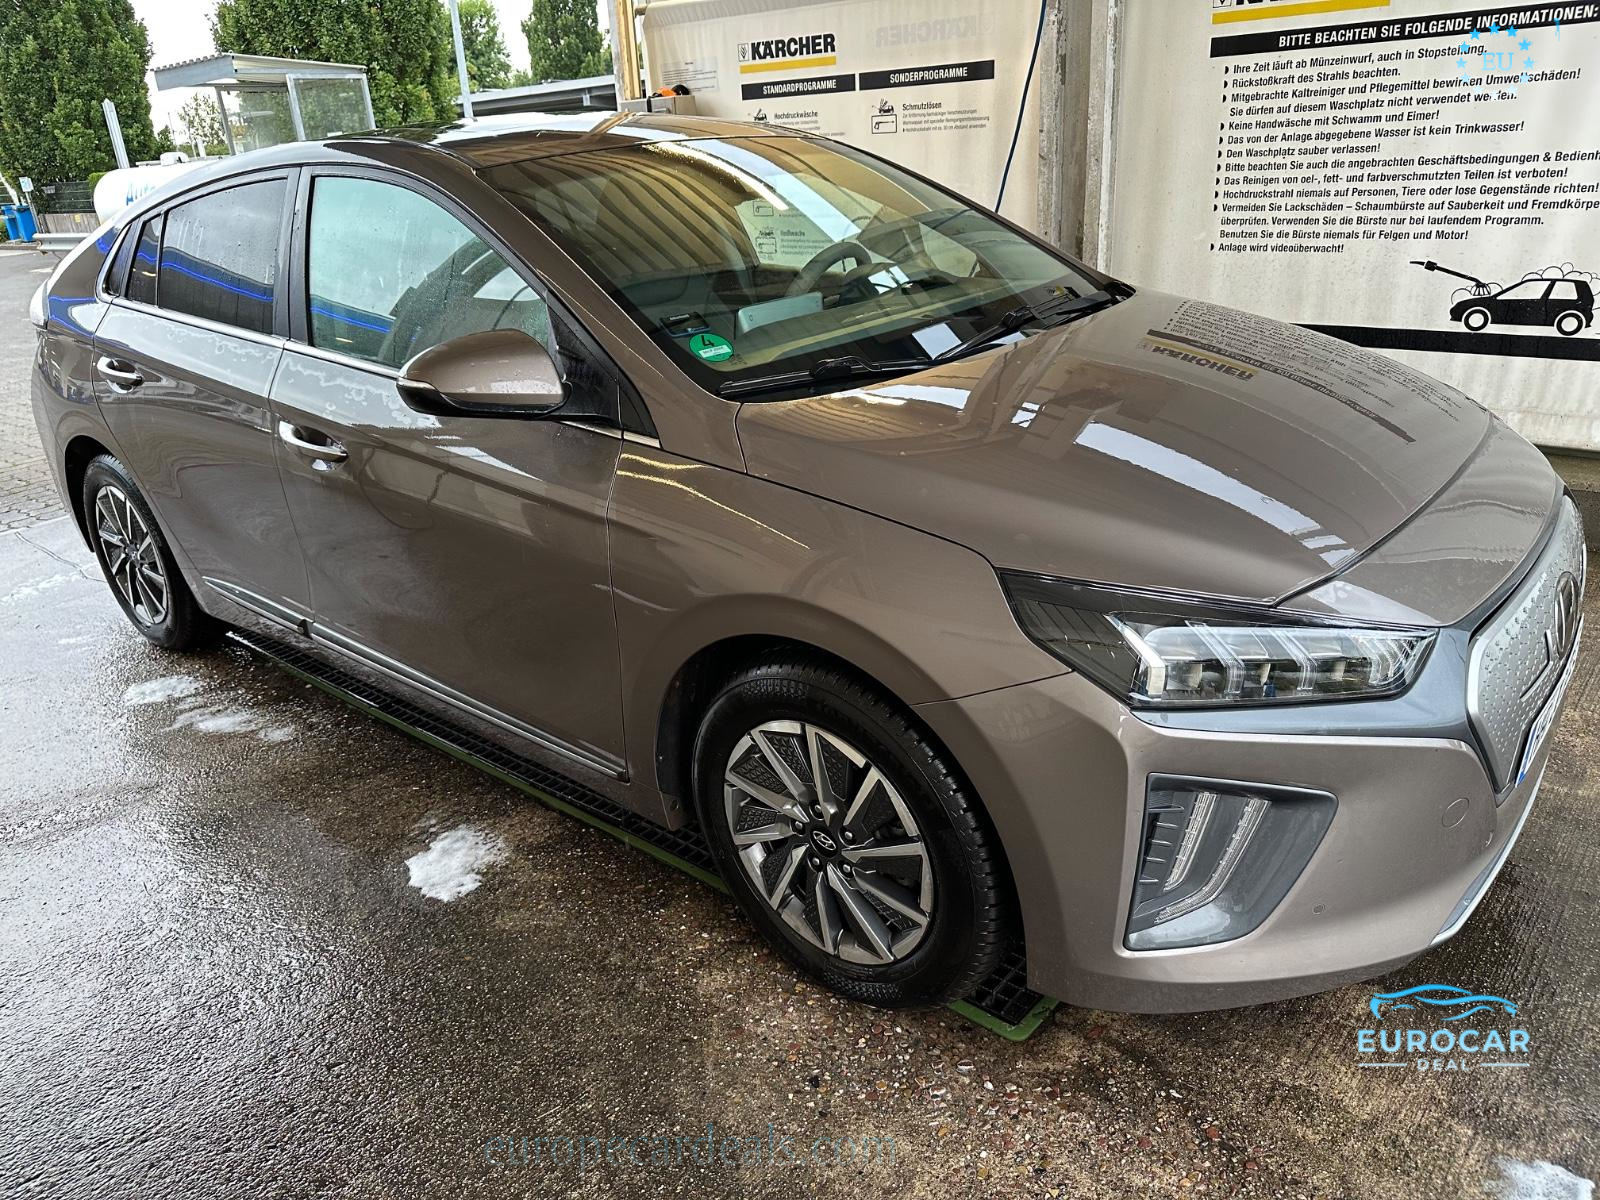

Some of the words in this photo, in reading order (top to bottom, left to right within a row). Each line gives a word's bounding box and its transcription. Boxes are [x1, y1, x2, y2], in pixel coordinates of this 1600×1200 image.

[1278, 34, 1312, 48] BITTE
[1314, 27, 1377, 44] BEACHTEN
[1380, 24, 1402, 38] SIE
[1404, 17, 1473, 36] FOLGENDE
[1476, 6, 1600, 29] INFORMATIONEN:
[751, 33, 836, 61] KÄRCHER
[1233, 64, 1251, 74] Ihre
[1252, 61, 1271, 73] Zeit
[1272, 59, 1294, 71] läuft
[1295, 58, 1308, 69] ab
[1309, 53, 1375, 68] Münzeinwurf,
[1376, 50, 1402, 62] auch
[1404, 49, 1415, 60] in
[1417, 44, 1488, 60] Stopstelung.
[890, 66, 968, 84] SONDERPROGRAMME
[1232, 75, 1296, 88] Rückstoßkraft
[1297, 73, 1315, 84] des
[1316, 70, 1350, 82] Strahls
[1352, 67, 1401, 80] beachten.
[763, 79, 836, 95] STANDARDPROGRAMME
[1231, 90, 1289, 104] Mitgebrachte
[1291, 86, 1346, 99] Kaltreiniger
[1348, 83, 1368, 95] und
[1369, 79, 1431, 95] Pflegemittel
[902, 101, 942, 111] Schmutzlösen
[1229, 106, 1244, 117] Sie
[1245, 105, 1275, 116] dürfen
[1276, 103, 1292, 114] auf
[1293, 102, 1327, 113] diesem
[1329, 98, 1385, 112] Waschplatz
[1387, 95, 1414, 107] nicht
[1415, 92, 1472, 106] verwendet
[774, 110, 818, 120] Hochdruckwäsche
[1228, 120, 1253, 131] Keine
[1255, 117, 1312, 130] Handwäsche
[1314, 116, 1330, 126] mit
[1331, 114, 1383, 126] Schwamm
[1384, 111, 1405, 123] und
[1406, 109, 1440, 122] Eimer!
[1227, 135, 1244, 145] Das
[1246, 135, 1262, 144] von
[1263, 133, 1279, 143] der
[1280, 132, 1313, 144] Anlage
[1314, 129, 1372, 142] abgegebene
[1374, 127, 1411, 138] Wasser
[1412, 125, 1427, 137] ist
[1428, 124, 1452, 136] kein
[1455, 120, 1525, 134] Trinkwasser!
[1226, 149, 1243, 159] Den
[1245, 146, 1296, 159] Waschplatz
[1297, 145, 1330, 156] sauber
[1331, 142, 1381, 154] verlassen!
[1225, 162, 1246, 172] Bitte
[1247, 161, 1288, 172] beachten
[1289, 160, 1304, 170] Sie
[1305, 159, 1329, 170] auch
[1330, 158, 1346, 169] die
[1347, 156, 1415, 170] angebrachten
[1417, 153, 1540, 167] Geschäftsbedingungen
[1542, 151, 1552, 162] &
[1224, 176, 1241, 186] Das
[1242, 175, 1280, 187] Reinigen
[1282, 176, 1299, 184] von
[1323, 173, 1343, 184] fett-
[1345, 172, 1365, 183] und
[1366, 170, 1461, 182] farbverschmutzten
[1463, 169, 1495, 180] Teilen
[1497, 168, 1512, 180] ist
[1514, 167, 1568, 179] verboten!
[1222, 188, 1294, 199] Hochdruckstrahl
[1295, 187, 1332, 198] niemals
[1333, 187, 1350, 198] auf
[1351, 187, 1399, 198] Personen,
[1401, 186, 1427, 196] Tiere
[1428, 185, 1453, 196] oder
[1454, 185, 1477, 196] lose
[1479, 183, 1551, 197] Gegenstände
[1552, 182, 1599, 194] richten!
[1221, 202, 1266, 212] Vermeiden
[1268, 202, 1283, 212] Sie
[1284, 201, 1344, 212] Lackschäden
[1354, 200, 1426, 211] Schaumbürste
[1427, 200, 1446, 211] auf
[1447, 199, 1505, 211] Sauberkeit
[1507, 199, 1529, 210] und
[1220, 216, 1269, 227] überprüfen.
[1271, 216, 1320, 226] Verwenden
[1322, 215, 1337, 226] Sie
[1339, 215, 1354, 226] die
[1355, 215, 1388, 226] Bürste
[1389, 217, 1407, 226] nur
[1408, 215, 1425, 226] bei
[1427, 214, 1482, 225] laufendem
[1484, 215, 1544, 227] Programm.
[1219, 229, 1258, 239] Benutzen
[1260, 229, 1274, 239] Sie
[1276, 229, 1290, 239] die
[1291, 229, 1321, 240] Bürste
[1322, 229, 1360, 240] niemals
[1362, 229, 1377, 240] für
[1378, 229, 1410, 242] Felgen
[1412, 229, 1433, 240] und
[1434, 229, 1469, 240] Motor!
[1217, 242, 1248, 254] Anlage
[1249, 242, 1269, 253] wird
[1270, 243, 1345, 253] videoüberwacht!
[701, 335, 715, 347] 4
